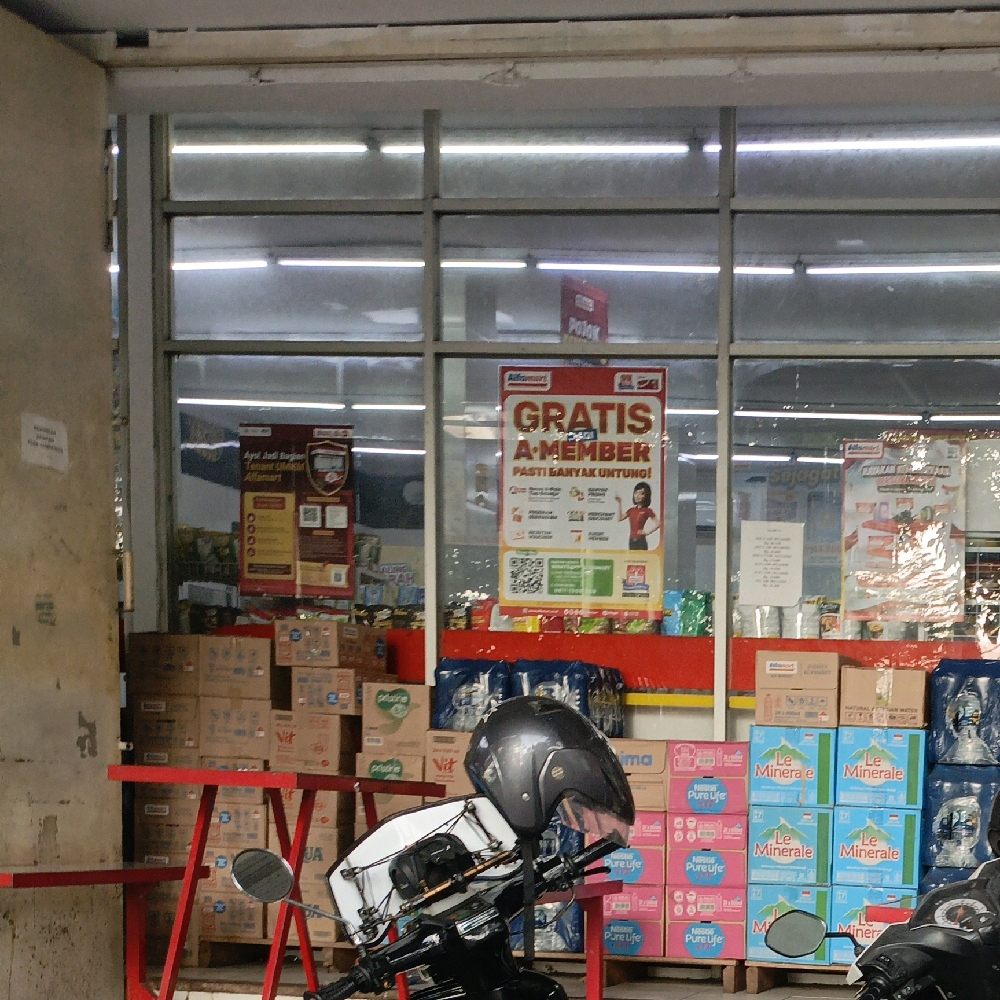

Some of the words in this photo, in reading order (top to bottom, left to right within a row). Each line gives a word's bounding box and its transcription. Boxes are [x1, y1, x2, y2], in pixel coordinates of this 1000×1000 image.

[513, 401, 653, 434] GRATIS
[512, 466, 546, 477] PASTI
[549, 467, 596, 478] BANYAK
[776, 752, 792, 767] Le
[866, 753, 882, 767] Le
[845, 765, 903, 780] Minerale
[688, 791, 709, 800] Pure
[710, 791, 727, 803] Life
[775, 831, 791, 846] Le
[862, 832, 878, 847] Le
[755, 843, 813, 858] Minerale
[840, 844, 899, 860] Minerale
[604, 860, 625, 868] Pure
[626, 860, 643, 872] Life
[686, 863, 707, 872] Pure
[707, 864, 725, 875] Life
[604, 932, 625, 941] Pure
[626, 933, 642, 944] Life
[686, 934, 707, 943] Pure
[707, 935, 724, 946] Life
